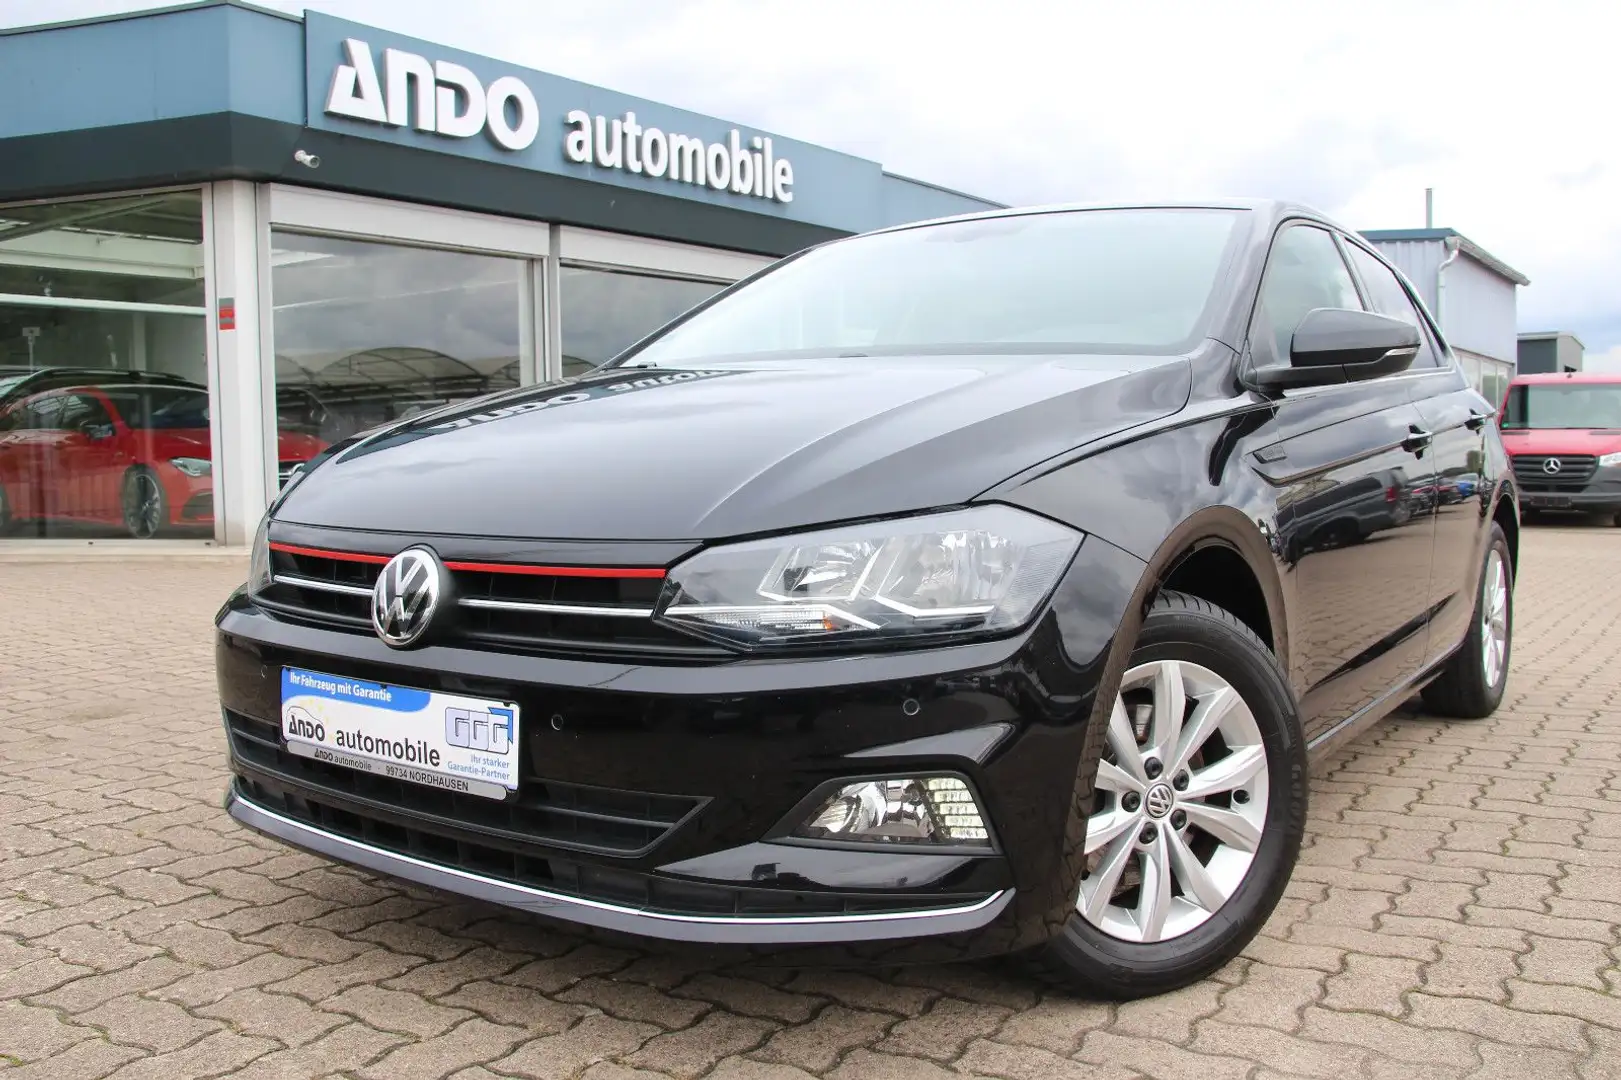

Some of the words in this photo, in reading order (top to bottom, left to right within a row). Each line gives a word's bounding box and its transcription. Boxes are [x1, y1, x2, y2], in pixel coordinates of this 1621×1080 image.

[324, 37, 540, 151] ANDO
[564, 109, 794, 204] automobile
[290, 672, 301, 685] Ihr
[301, 674, 336, 694] Fahrzeug
[337, 681, 352, 695] mit
[353, 685, 393, 702] Garantie
[336, 729, 441, 767] automobile
[471, 755, 482, 765] Ihr
[482, 757, 510, 769] starker
[334, 754, 372, 771] automobile
[386, 766, 408, 779] 99734
[409, 770, 469, 792] NORDHAUSEN
[447, 761, 510, 780] Garantie-Partner
